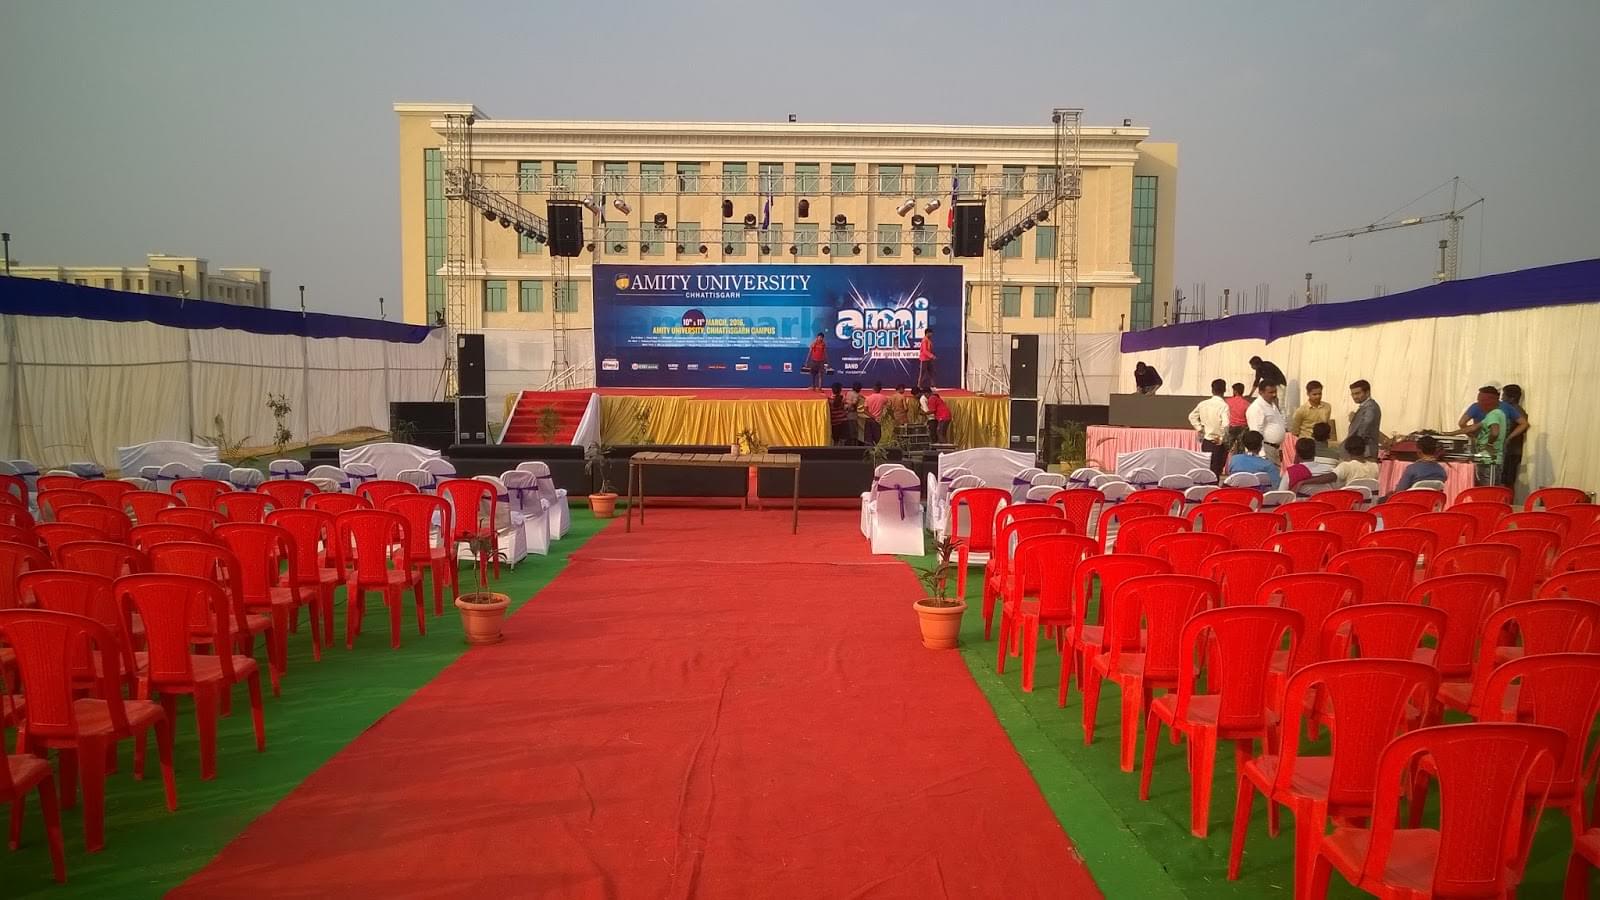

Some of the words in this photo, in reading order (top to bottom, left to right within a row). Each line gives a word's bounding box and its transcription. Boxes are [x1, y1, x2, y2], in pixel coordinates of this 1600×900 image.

[631, 275, 691, 290] AMITY
[697, 275, 811, 290] UNIVERSITY
[652, 326, 670, 335] AMITY
[751, 326, 776, 335] CAMPUS
[852, 326, 911, 355] spark
